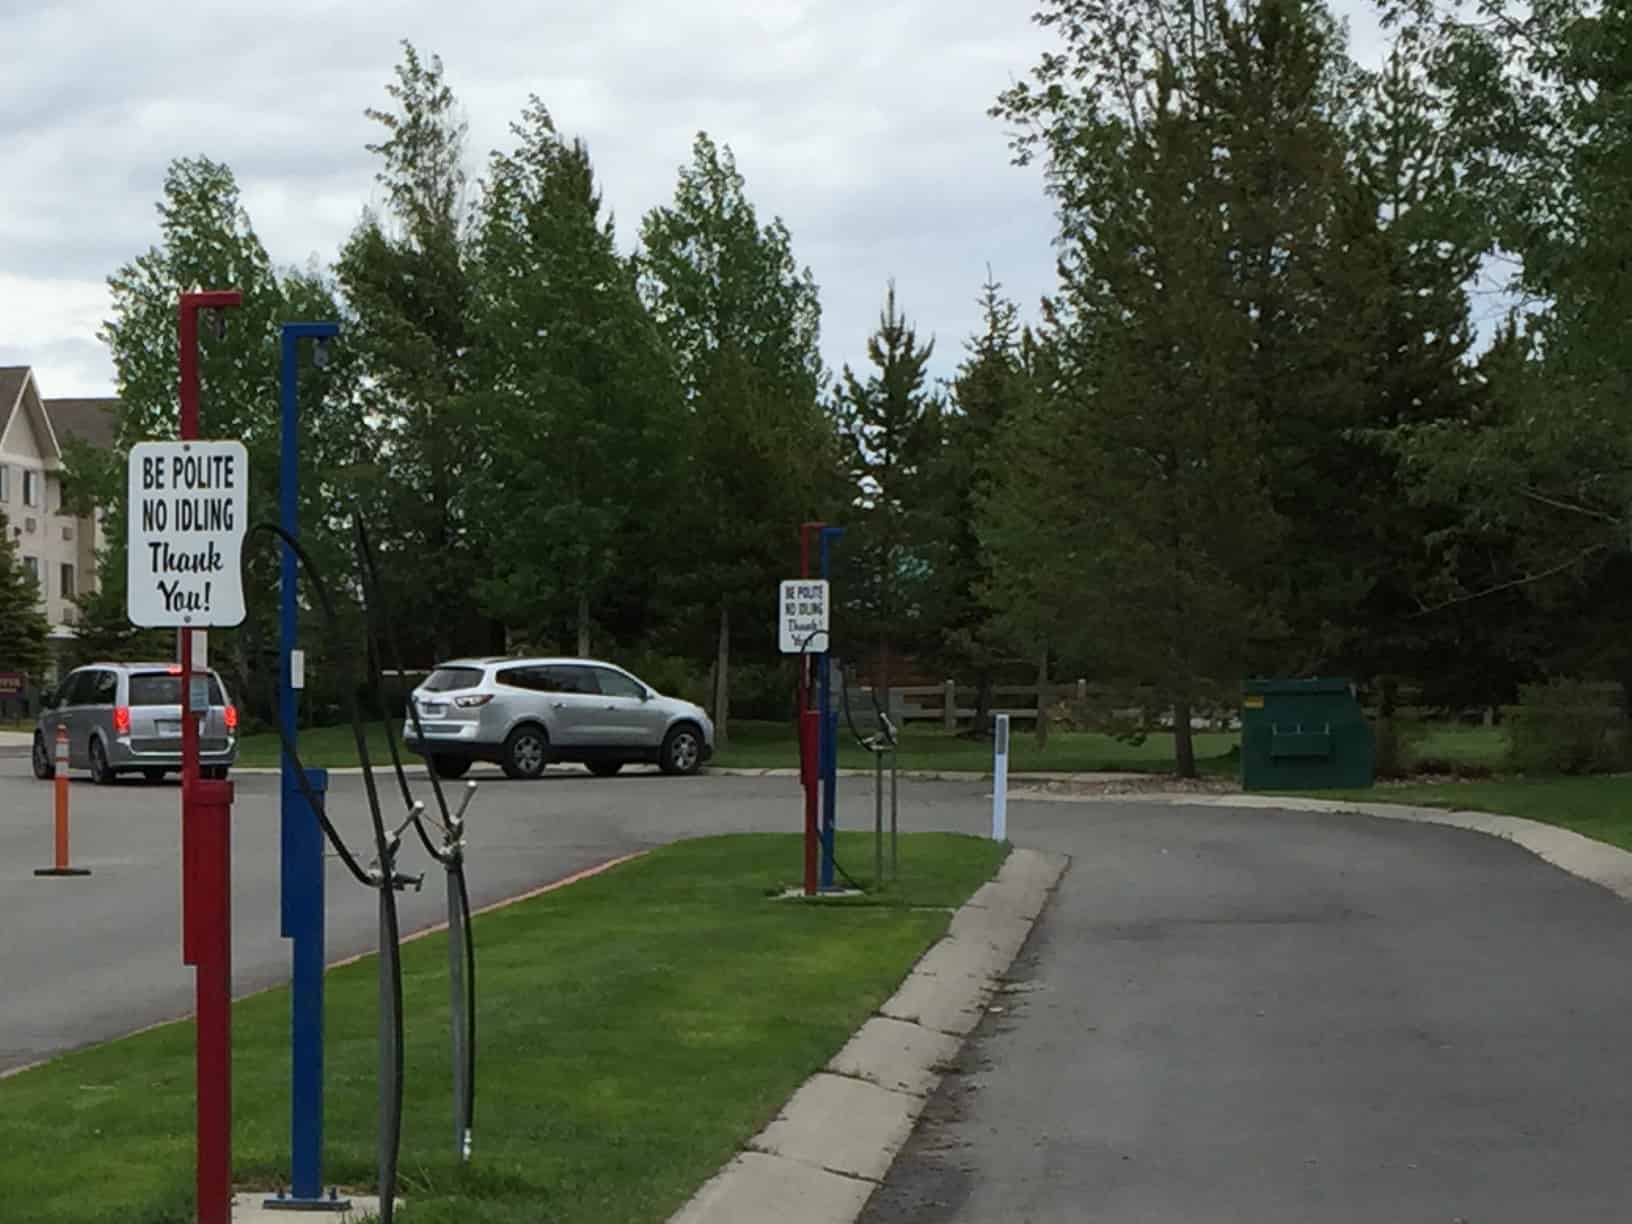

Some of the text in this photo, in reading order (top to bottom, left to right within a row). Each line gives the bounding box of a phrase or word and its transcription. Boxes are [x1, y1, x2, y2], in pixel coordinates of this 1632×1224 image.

[143, 455, 234, 489] BE POLITE
[142, 498, 233, 532] NO IDLING
[148, 541, 223, 573] Thank
[157, 580, 211, 612] You!
